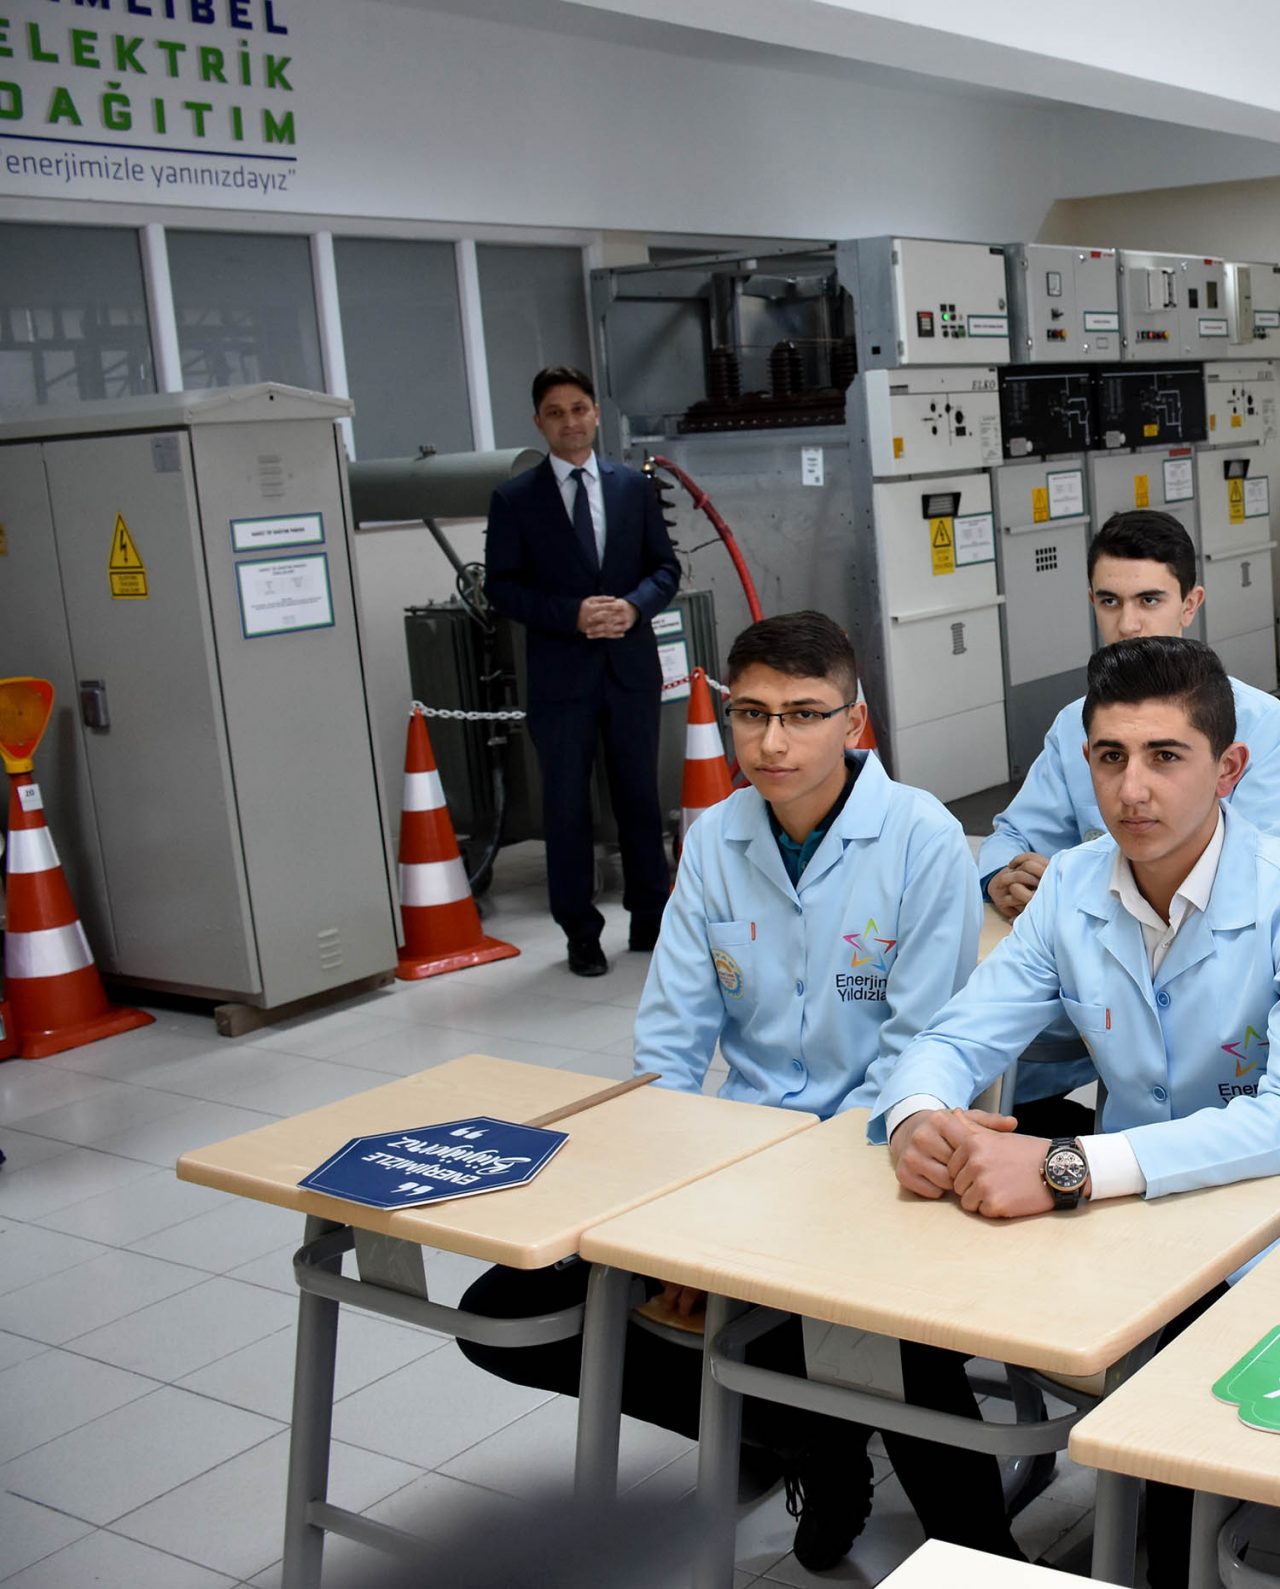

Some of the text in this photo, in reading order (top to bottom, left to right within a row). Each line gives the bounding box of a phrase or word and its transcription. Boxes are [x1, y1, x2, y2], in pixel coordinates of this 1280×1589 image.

[0, 80, 296, 145] DAĞITIM
[836, 973, 888, 990] Enerjin
[837, 987, 887, 1002] Yıldızla
[361, 1151, 481, 1185] ENERJİMİZLE
